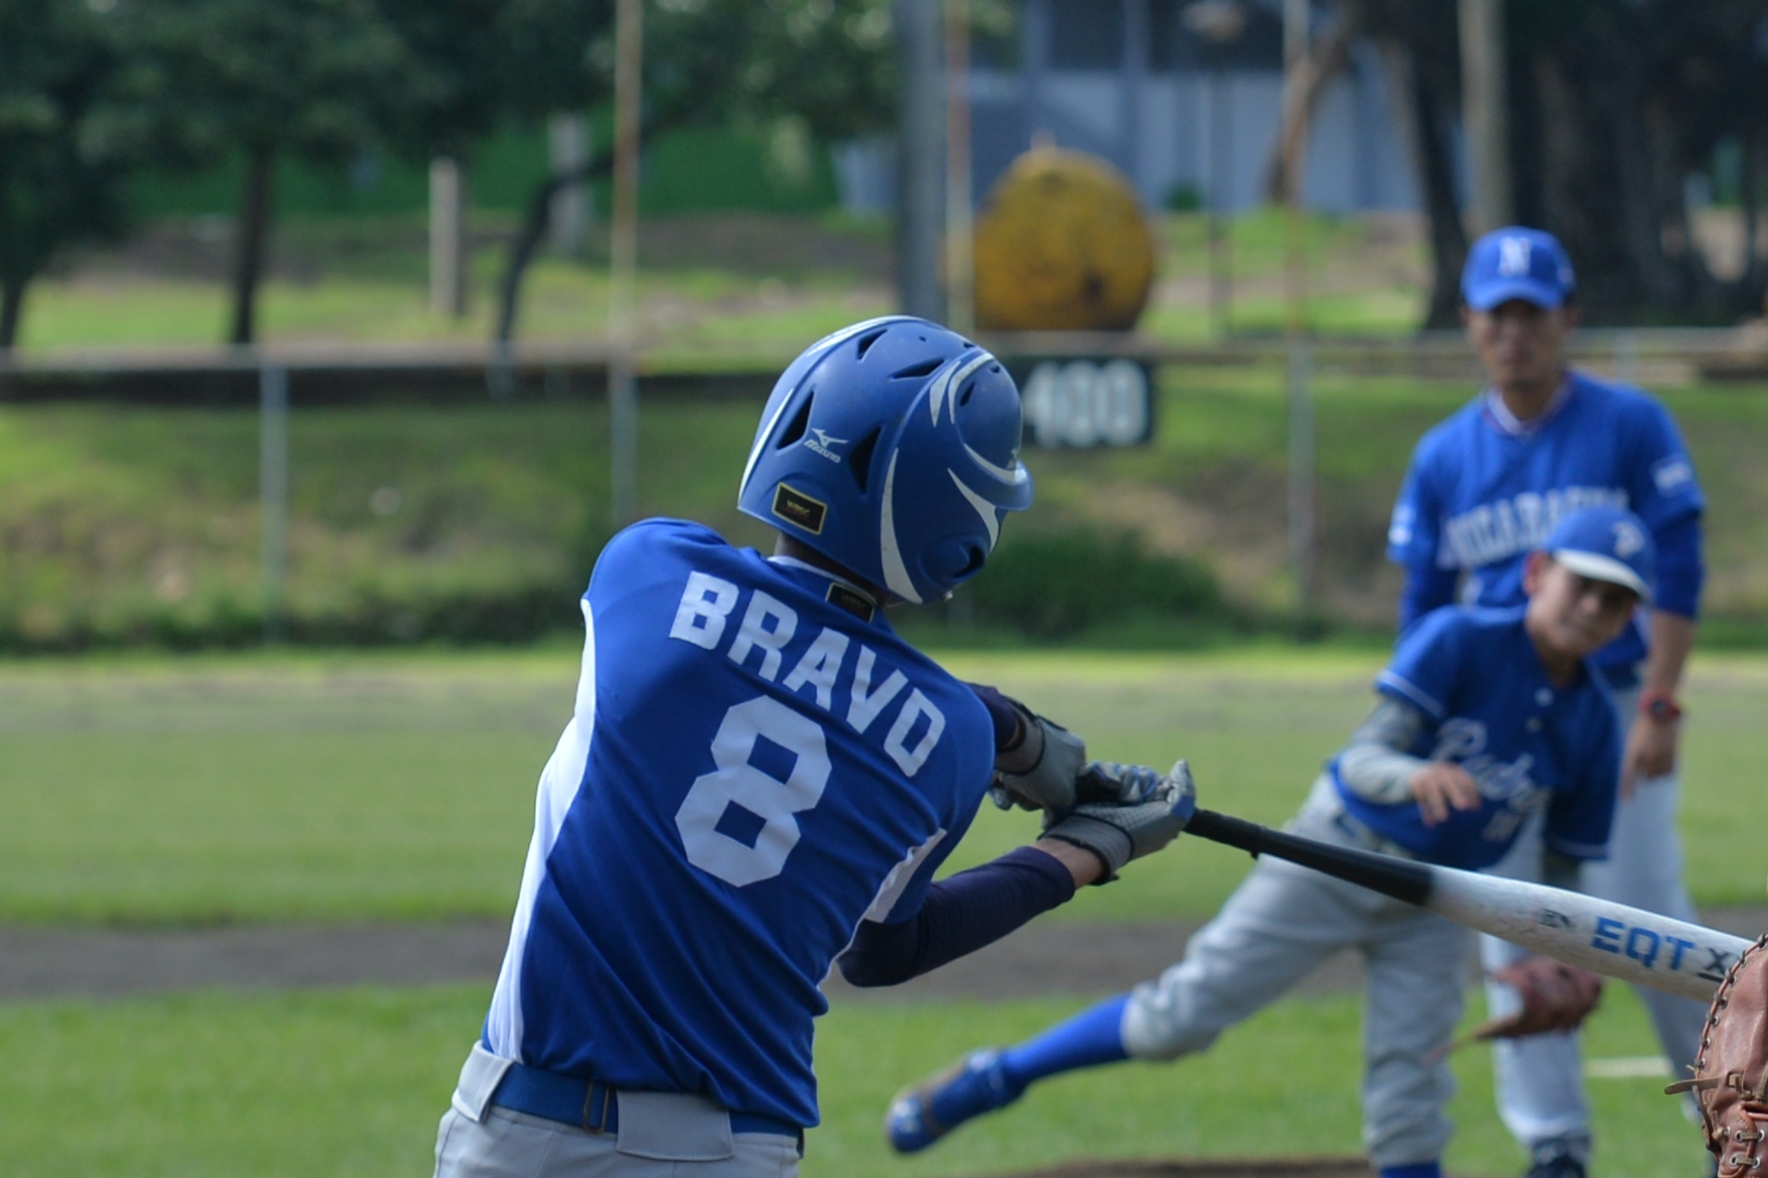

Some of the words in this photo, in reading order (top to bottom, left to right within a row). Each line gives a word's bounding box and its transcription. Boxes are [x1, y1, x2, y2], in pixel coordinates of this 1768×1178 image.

[669, 570, 945, 778] BRAVO
[674, 694, 832, 888] 8
[1592, 916, 1695, 971] EQT
